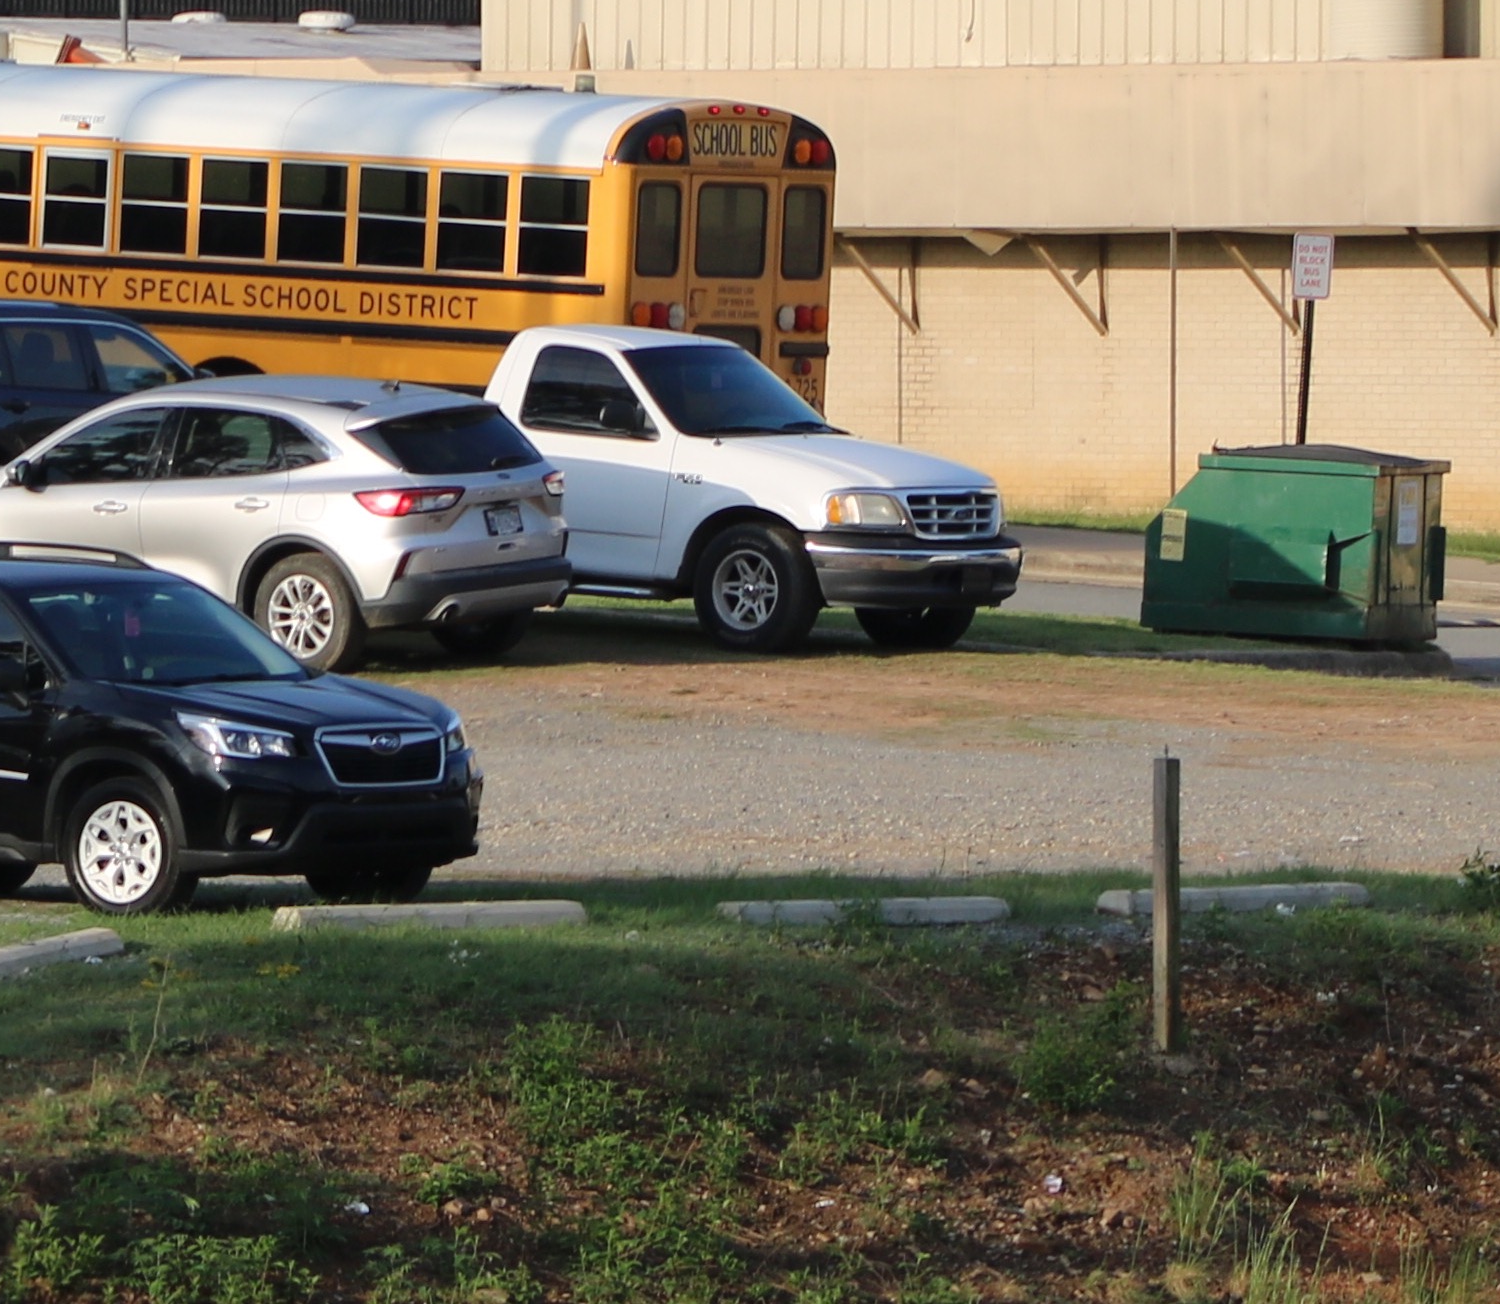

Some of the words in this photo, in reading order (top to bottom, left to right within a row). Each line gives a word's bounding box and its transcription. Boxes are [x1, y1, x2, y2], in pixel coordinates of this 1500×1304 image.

[693, 123, 746, 156] SCHOOL
[750, 125, 777, 157] BUS
[1299, 245, 1310, 253] DO
[1312, 246, 1328, 254] NOT
[1299, 256, 1326, 264] BLOCK
[1304, 267, 1320, 276] BUS
[1301, 279, 1321, 288] LANE
[5, 270, 108, 299] COUNTY
[123, 278, 235, 306] SPECIAL
[242, 284, 347, 313] SCHOOL
[359, 291, 478, 320] DISTRICT
